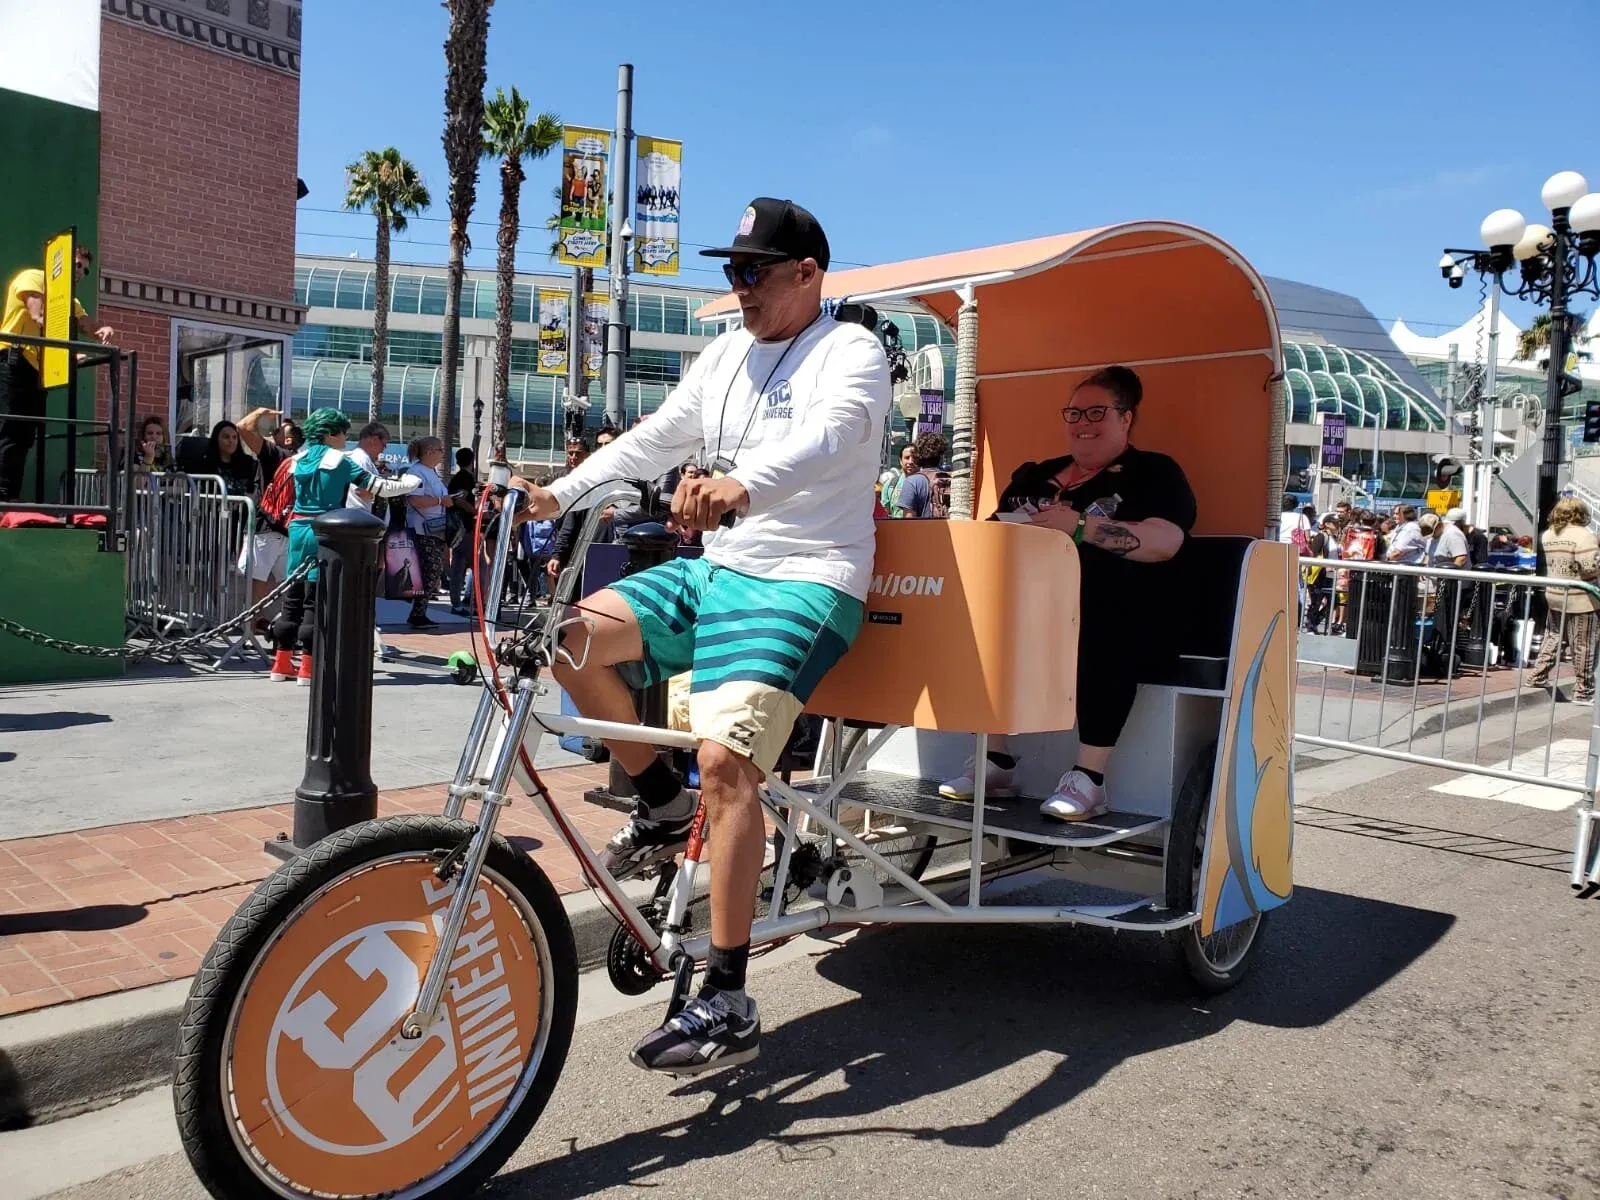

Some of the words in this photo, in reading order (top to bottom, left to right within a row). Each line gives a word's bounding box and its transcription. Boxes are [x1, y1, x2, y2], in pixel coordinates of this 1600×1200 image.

[768, 383, 791, 407] DC
[927, 402, 942, 416] YEARS
[1330, 426, 1344, 438] YEARS
